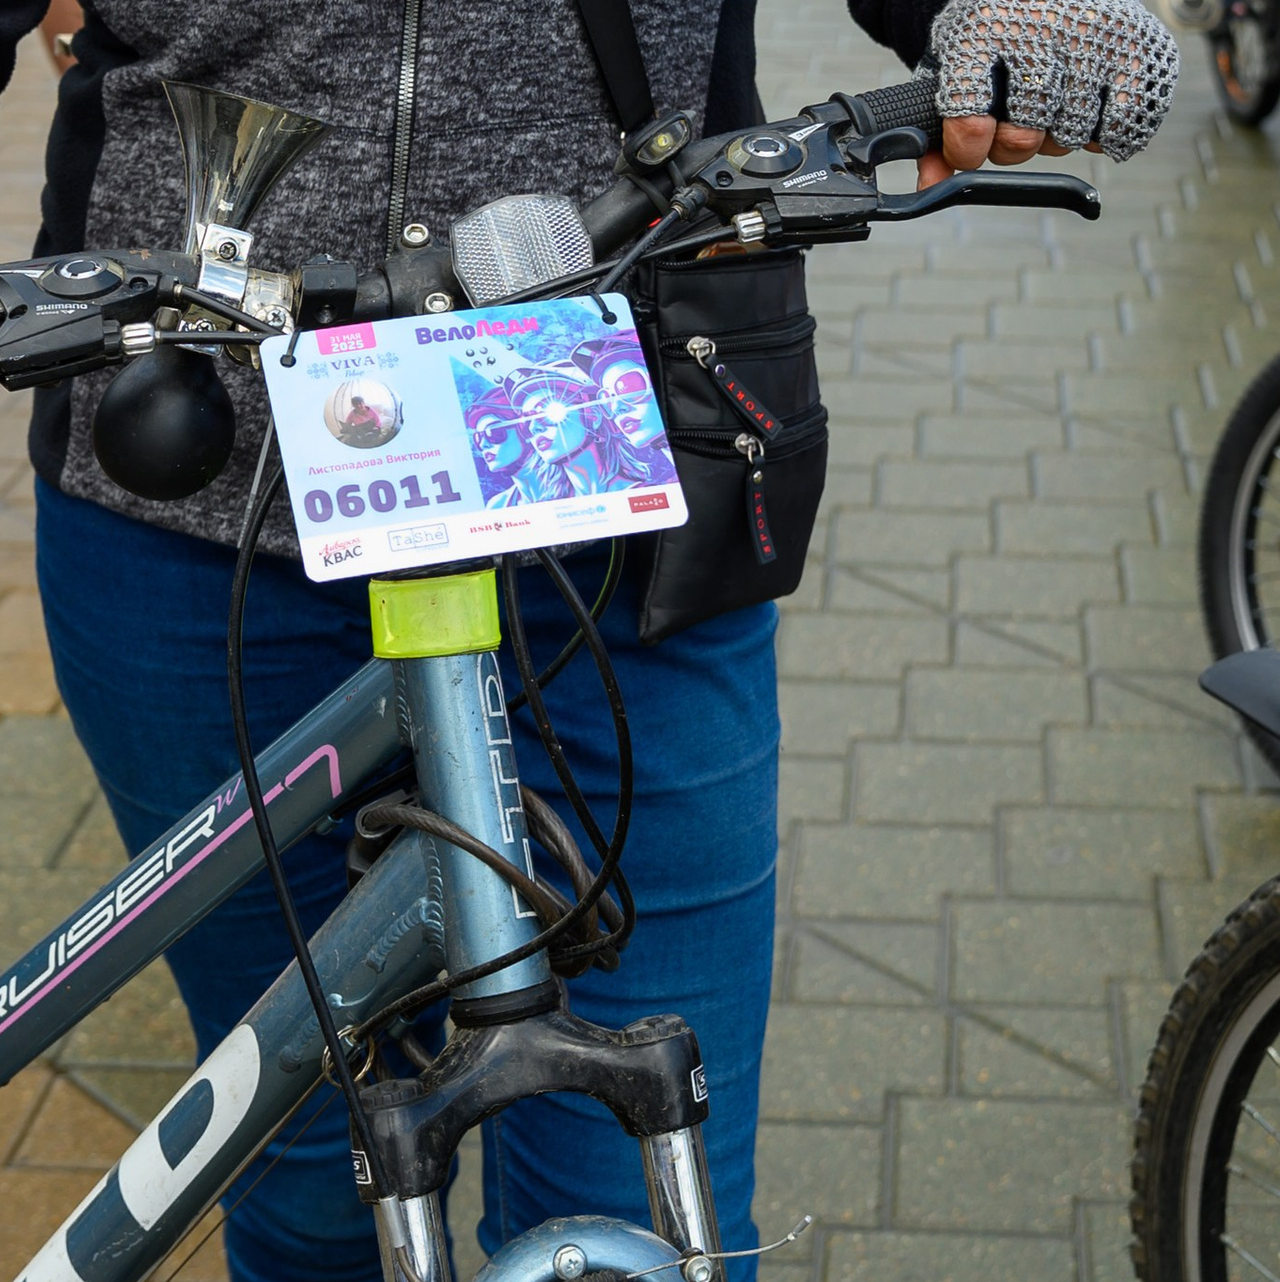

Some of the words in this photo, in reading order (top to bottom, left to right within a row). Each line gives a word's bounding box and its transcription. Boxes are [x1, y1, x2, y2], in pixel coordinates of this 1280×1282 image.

[783, 170, 827, 188] SHIMANO
[36, 303, 88, 312] SHIMANO
[415, 317, 539, 345] ВелоЛеди
[331, 339, 364, 353] 2025
[331, 356, 375, 370] VIVA
[727, 382, 773, 430] SPORT
[308, 458, 383, 475] Листопадова
[386, 449, 441, 464] Виктория
[304, 470, 462, 523] 06011
[323, 545, 363, 567] КВАС
